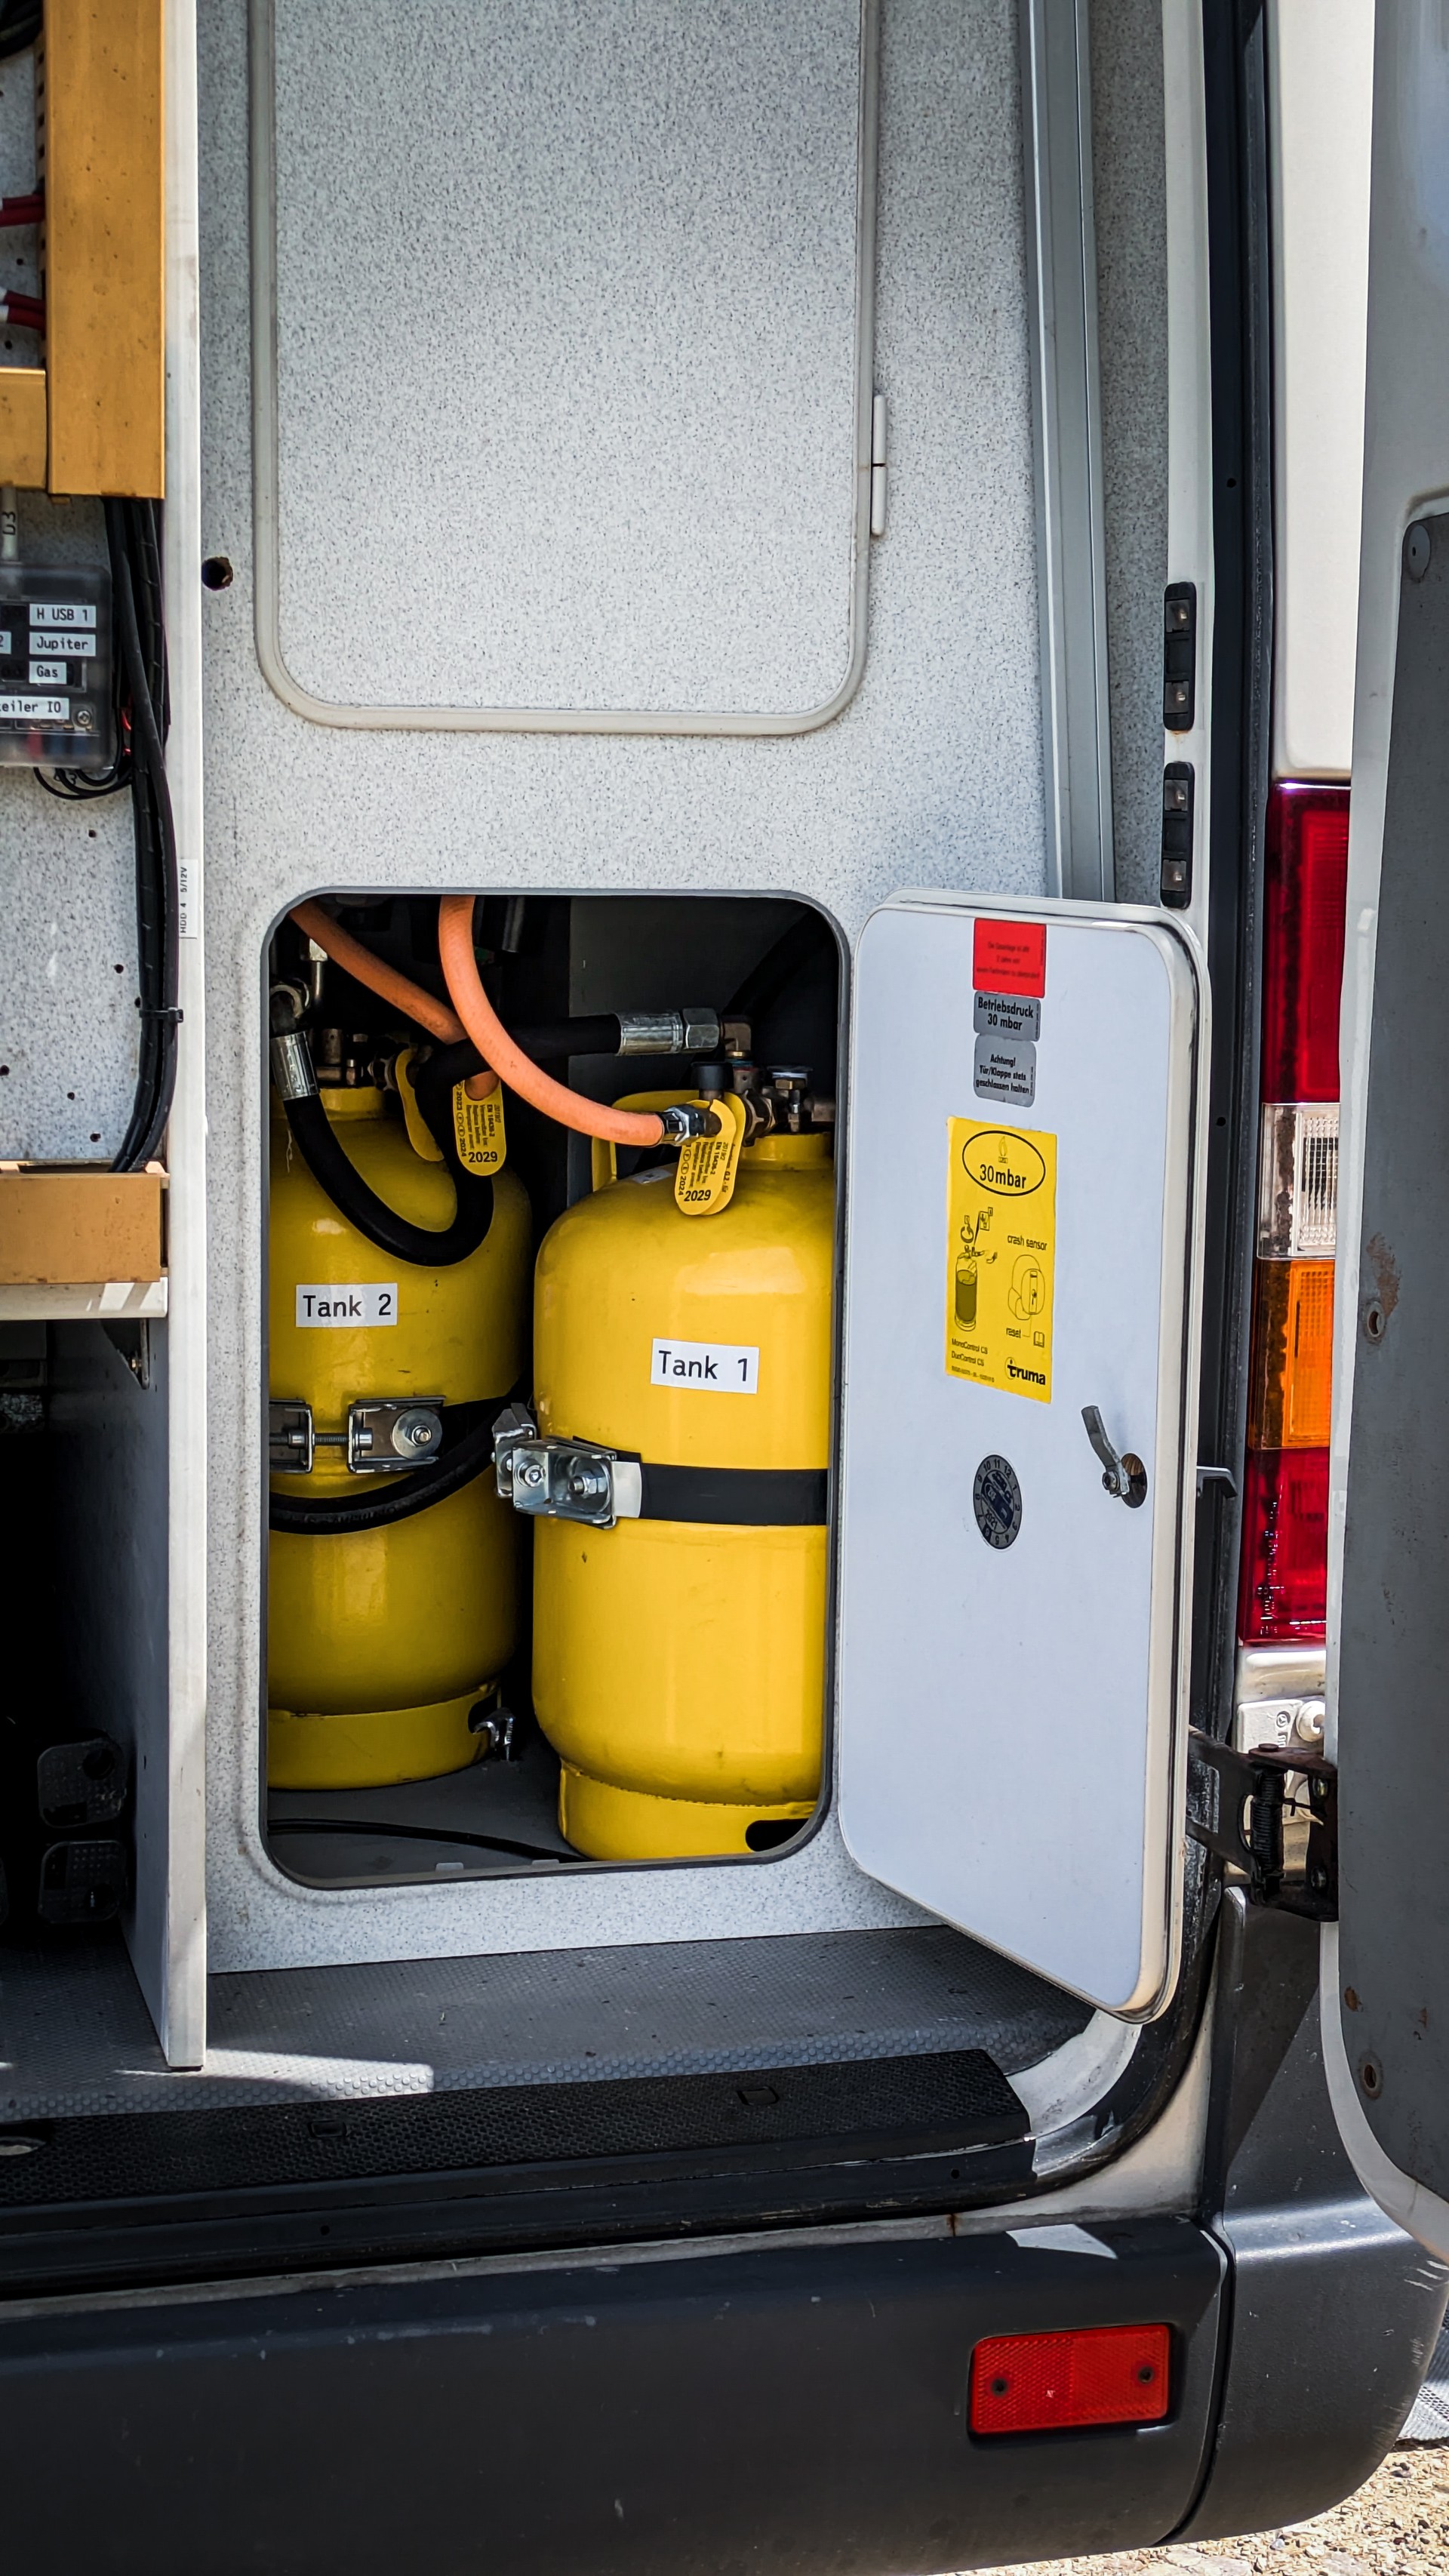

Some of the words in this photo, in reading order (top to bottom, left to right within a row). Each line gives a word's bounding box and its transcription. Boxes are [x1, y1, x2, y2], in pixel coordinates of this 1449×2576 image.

[36, 608, 45, 620] H
[52, 608, 74, 620] USB
[82, 609, 88, 621] 1
[36, 636, 88, 651] Jupiter
[36, 665, 58, 678] Gas
[0, 700, 38, 712] eiler
[180, 866, 188, 893] 5/12V
[978, 996, 1033, 1018] Betriebsdruck
[987, 1013, 998, 1026] 30
[1000, 1016, 1023, 1031] mbar
[990, 1054, 1016, 1068] Achtung!
[980, 1064, 1011, 1079] Tür/Klappe
[976, 1079, 1009, 1091] geschlossen
[1011, 1082, 1029, 1094] halten
[459, 1137, 467, 1157] 2024
[715, 1141, 722, 1150] EN
[468, 1151, 498, 1163] 2029
[678, 1175, 687, 1196] 2024
[684, 1190, 711, 1202] 2029
[1008, 1235, 1024, 1246] crash
[1026, 1239, 1048, 1250] sensor
[303, 1294, 362, 1317] Tank
[378, 1293, 392, 1316] 2
[1006, 1328, 1021, 1338] reset
[952, 1338, 980, 1352] MonoControl
[952, 1350, 976, 1364] DuoControl
[658, 1350, 718, 1380] Tank
[737, 1358, 748, 1381] 1
[1007, 1361, 1046, 1385] truma
[983, 1460, 991, 1472] 10
[994, 1459, 1001, 1469] 11
[1004, 1466, 1011, 1478] 12
